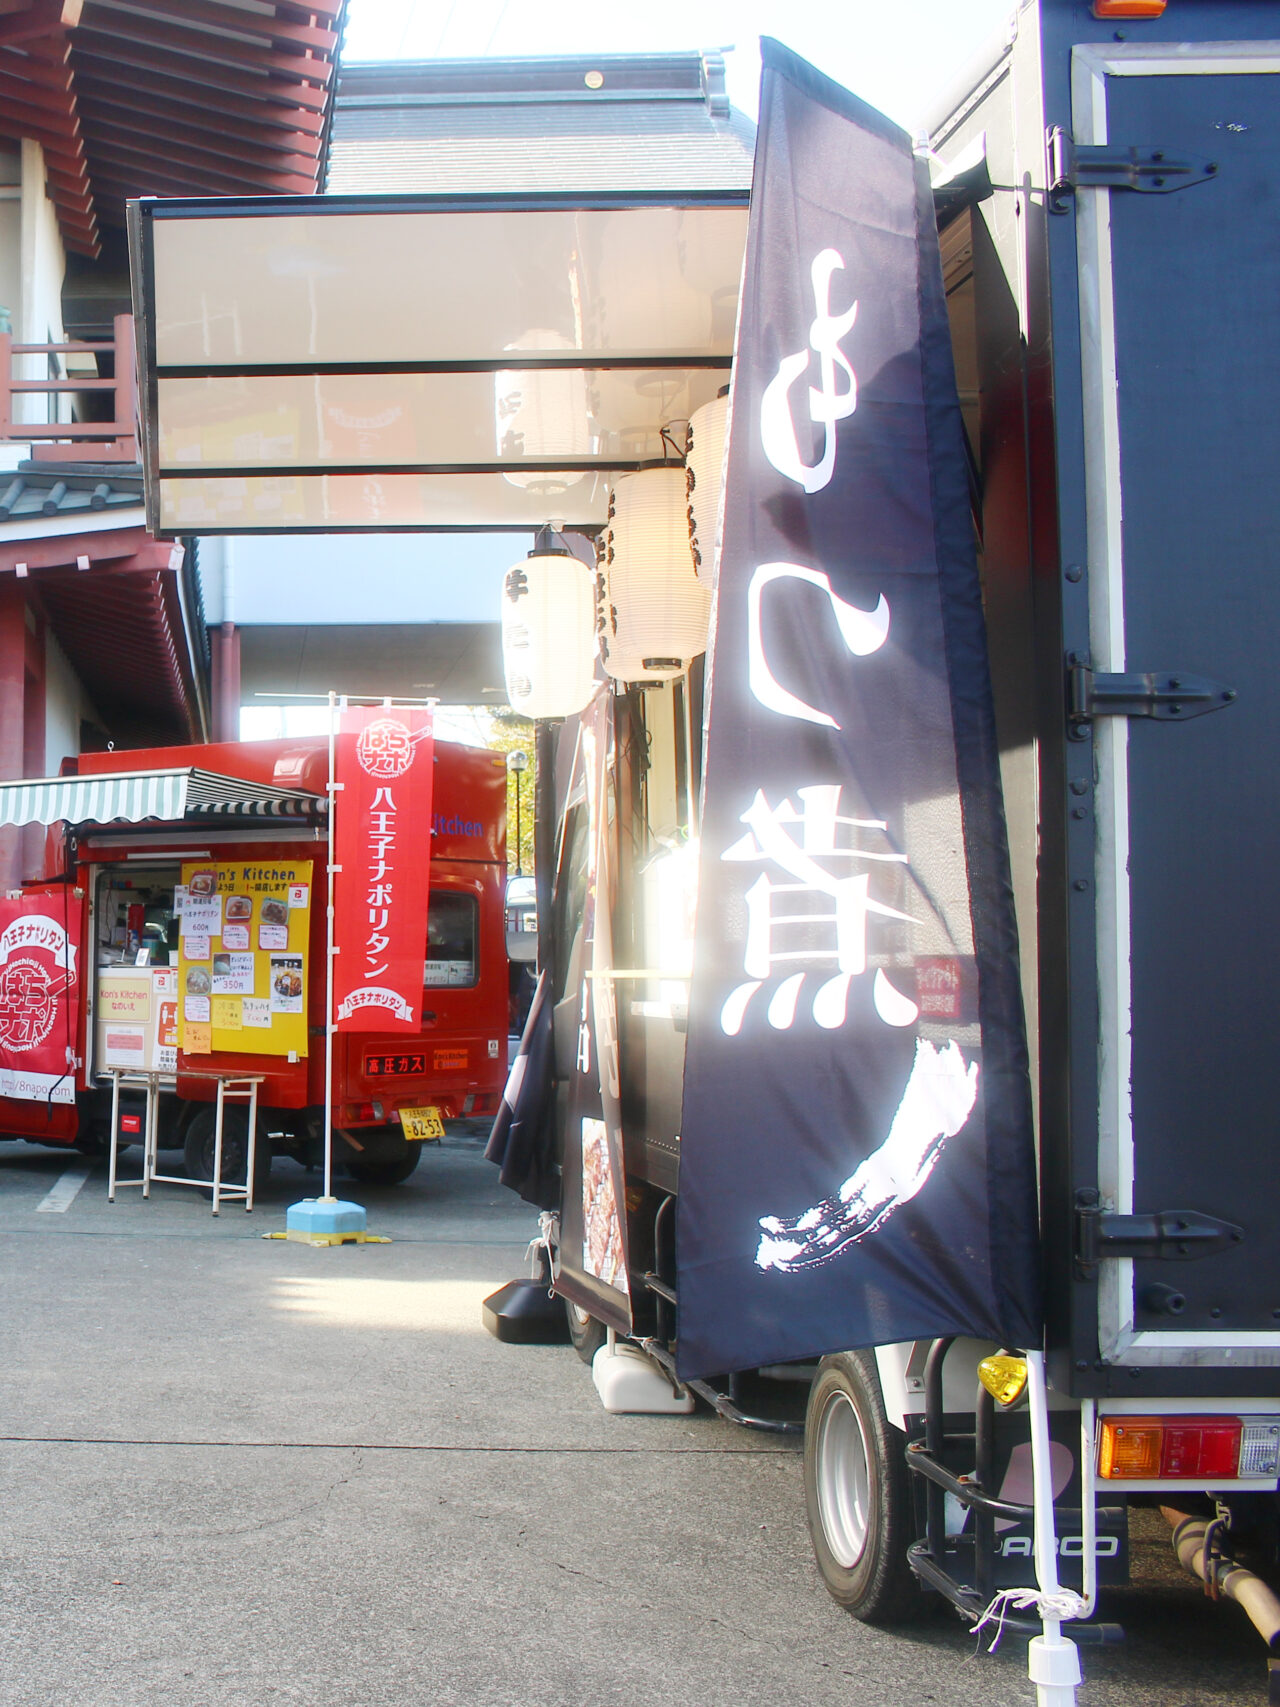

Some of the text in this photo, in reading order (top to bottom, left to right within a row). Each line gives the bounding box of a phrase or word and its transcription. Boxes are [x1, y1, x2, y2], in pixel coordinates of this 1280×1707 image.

[434, 813, 484, 837] itchen
[243, 867, 296, 880] Kitchen
[364, 787, 397, 978] 八王子ナポリタン
[3, 925, 64, 951] 八王子ナポリタン
[0, 971, 48, 1006] はち
[120, 989, 148, 999] Kitchen
[346, 992, 402, 1010] 八王子ナポリタン
